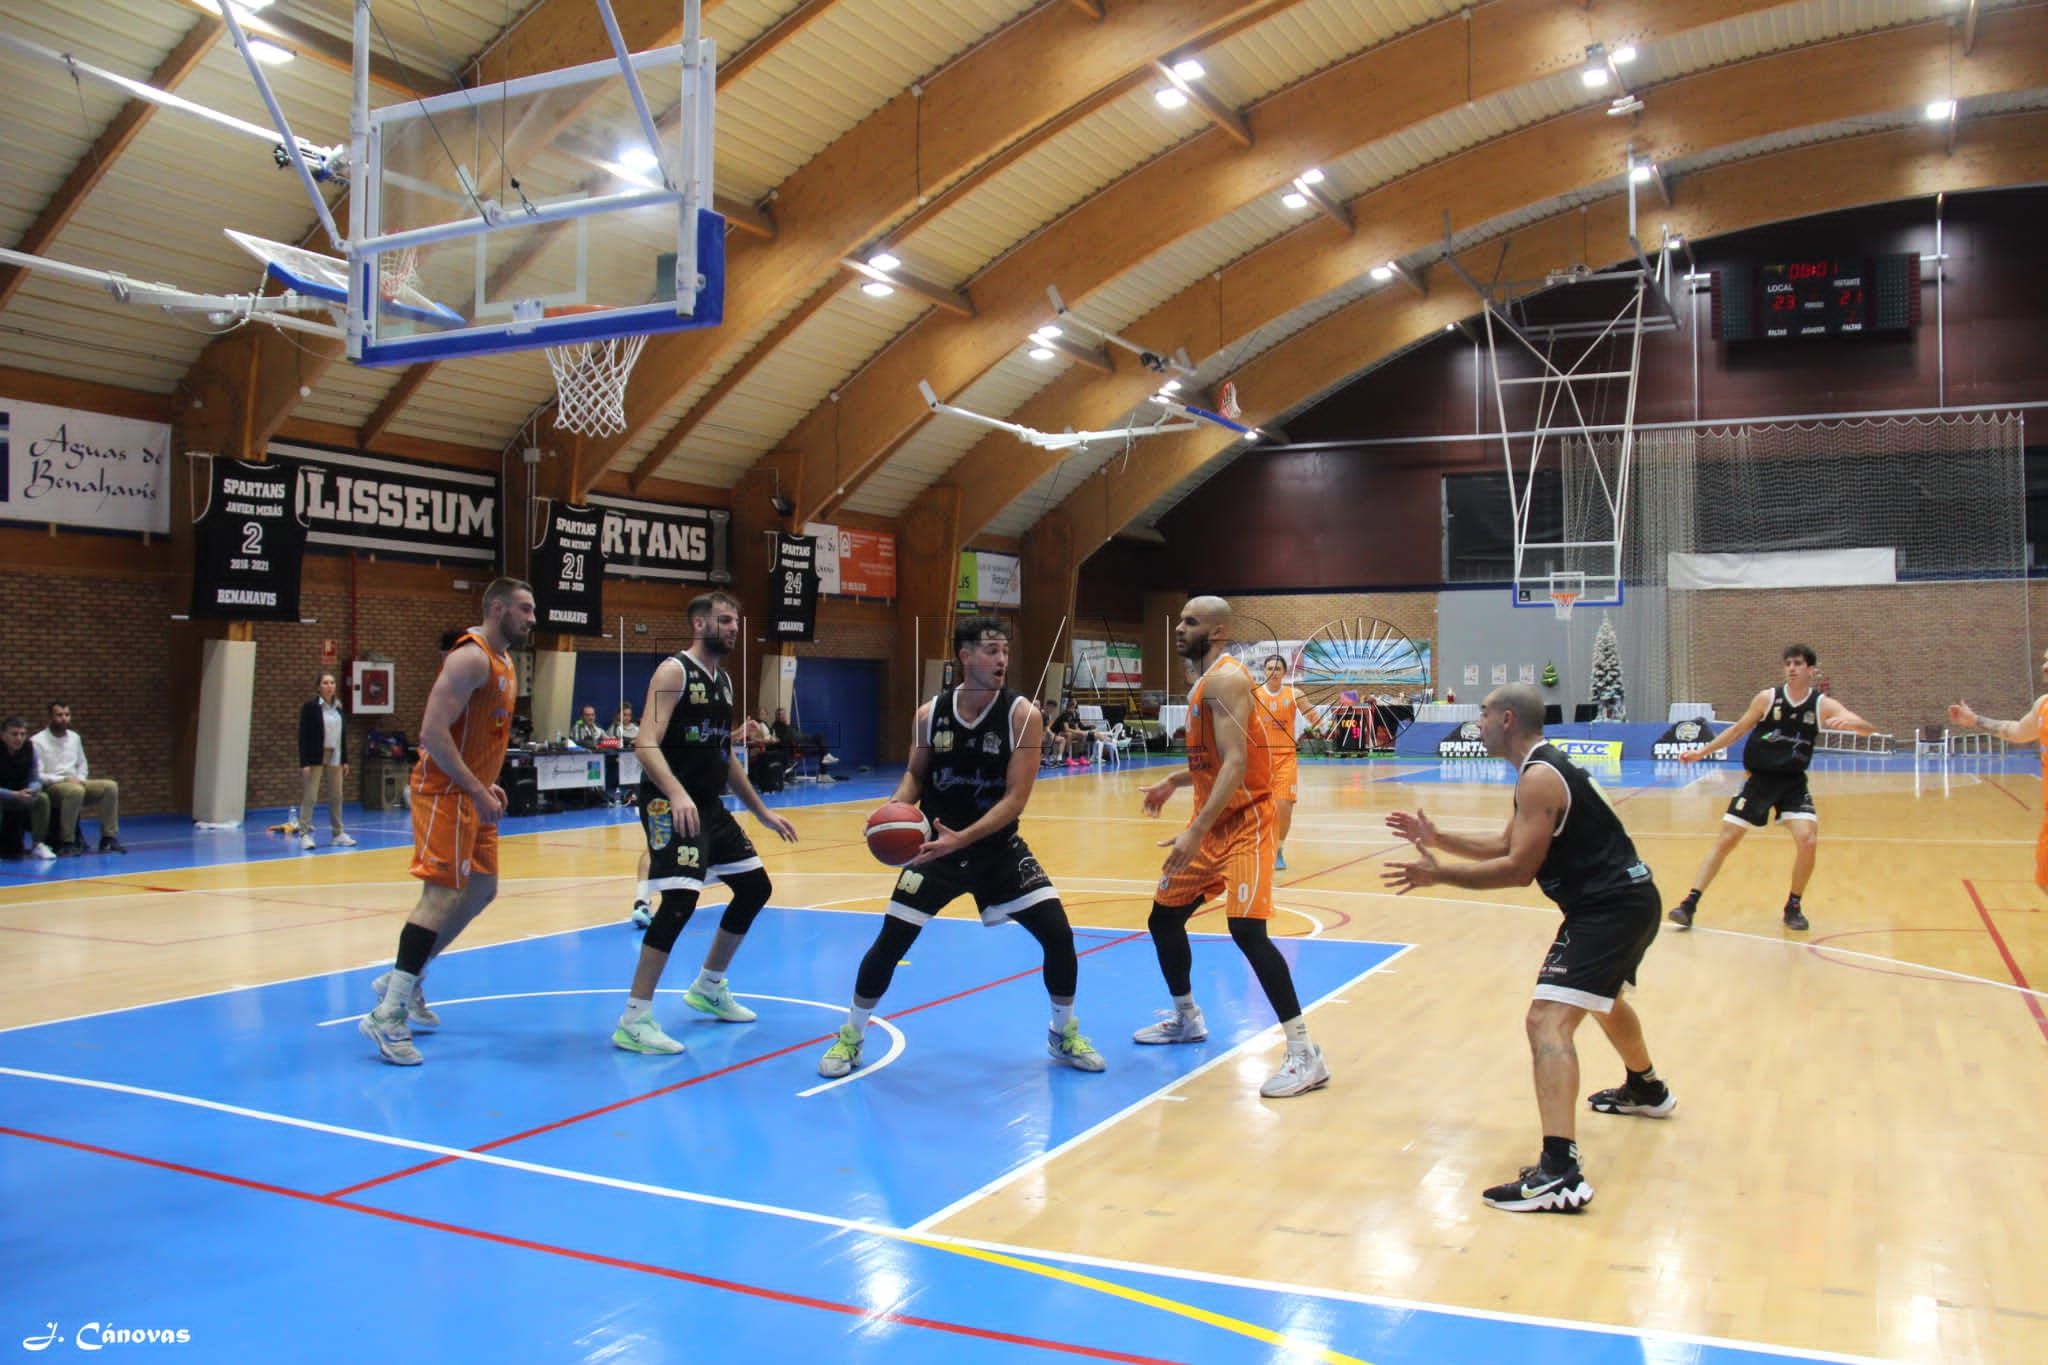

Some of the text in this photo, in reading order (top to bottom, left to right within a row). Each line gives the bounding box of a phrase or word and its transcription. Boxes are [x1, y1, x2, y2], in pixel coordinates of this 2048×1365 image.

[1767, 283, 1794, 293] LOCAL
[29, 423, 161, 469] Aguas de
[223, 478, 286, 499] SPARTANS
[241, 521, 264, 554] 2
[555, 517, 597, 537] SPARTANS
[561, 552, 585, 580] 21
[784, 571, 803, 594] 24
[677, 845, 700, 868] 32
